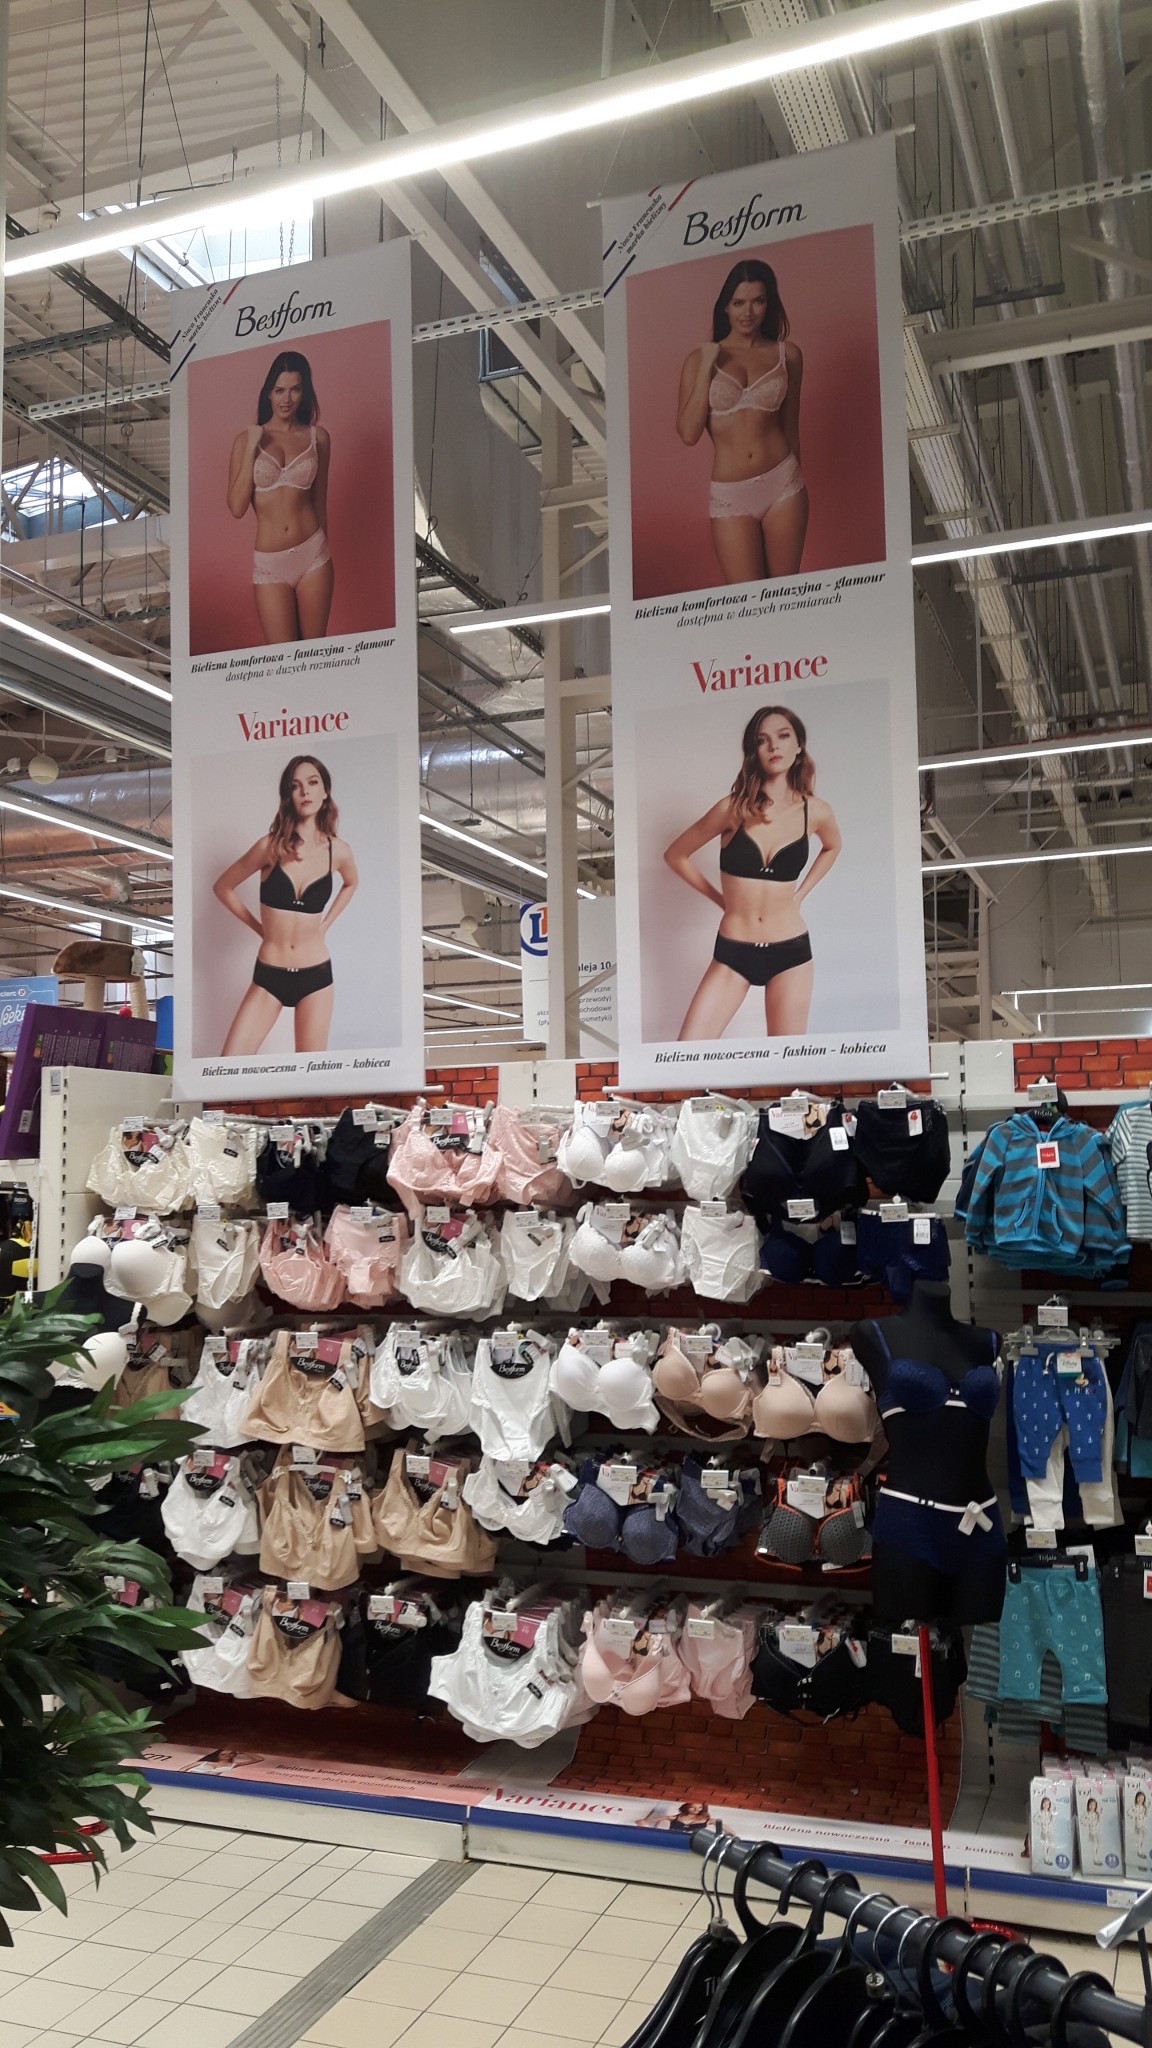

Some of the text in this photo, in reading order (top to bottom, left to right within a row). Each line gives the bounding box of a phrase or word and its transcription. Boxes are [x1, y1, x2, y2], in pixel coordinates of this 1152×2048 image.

[683, 193, 808, 247] Bestform
[234, 290, 337, 338] Bestform
[634, 571, 887, 620] Bielizna komfortowa fantazyjna glamour
[676, 611, 724, 628] dostępna
[726, 611, 736, 620] w
[779, 592, 843, 613] rozmiarach
[191, 638, 396, 674] Bielizna komfortowa fantazyjna glamour
[225, 668, 265, 682] dostępna
[309, 655, 361, 671] rozmiarach
[689, 654, 829, 694] Variance
[236, 708, 350, 742] Variance
[600, 961, 612, 971] 10
[201, 1058, 391, 1077] Bielizna nowoczesna fashion kobieca
[654, 1043, 888, 1063] Bielizna nowoczesna fashion kobieca
[490, 1638, 520, 1654] Bestform
[495, 1787, 624, 1816] Variance
[763, 1823, 812, 1834] Bielizna
[815, 1830, 891, 1843] nowoczesna
[964, 1845, 1015, 1858] kobieca
